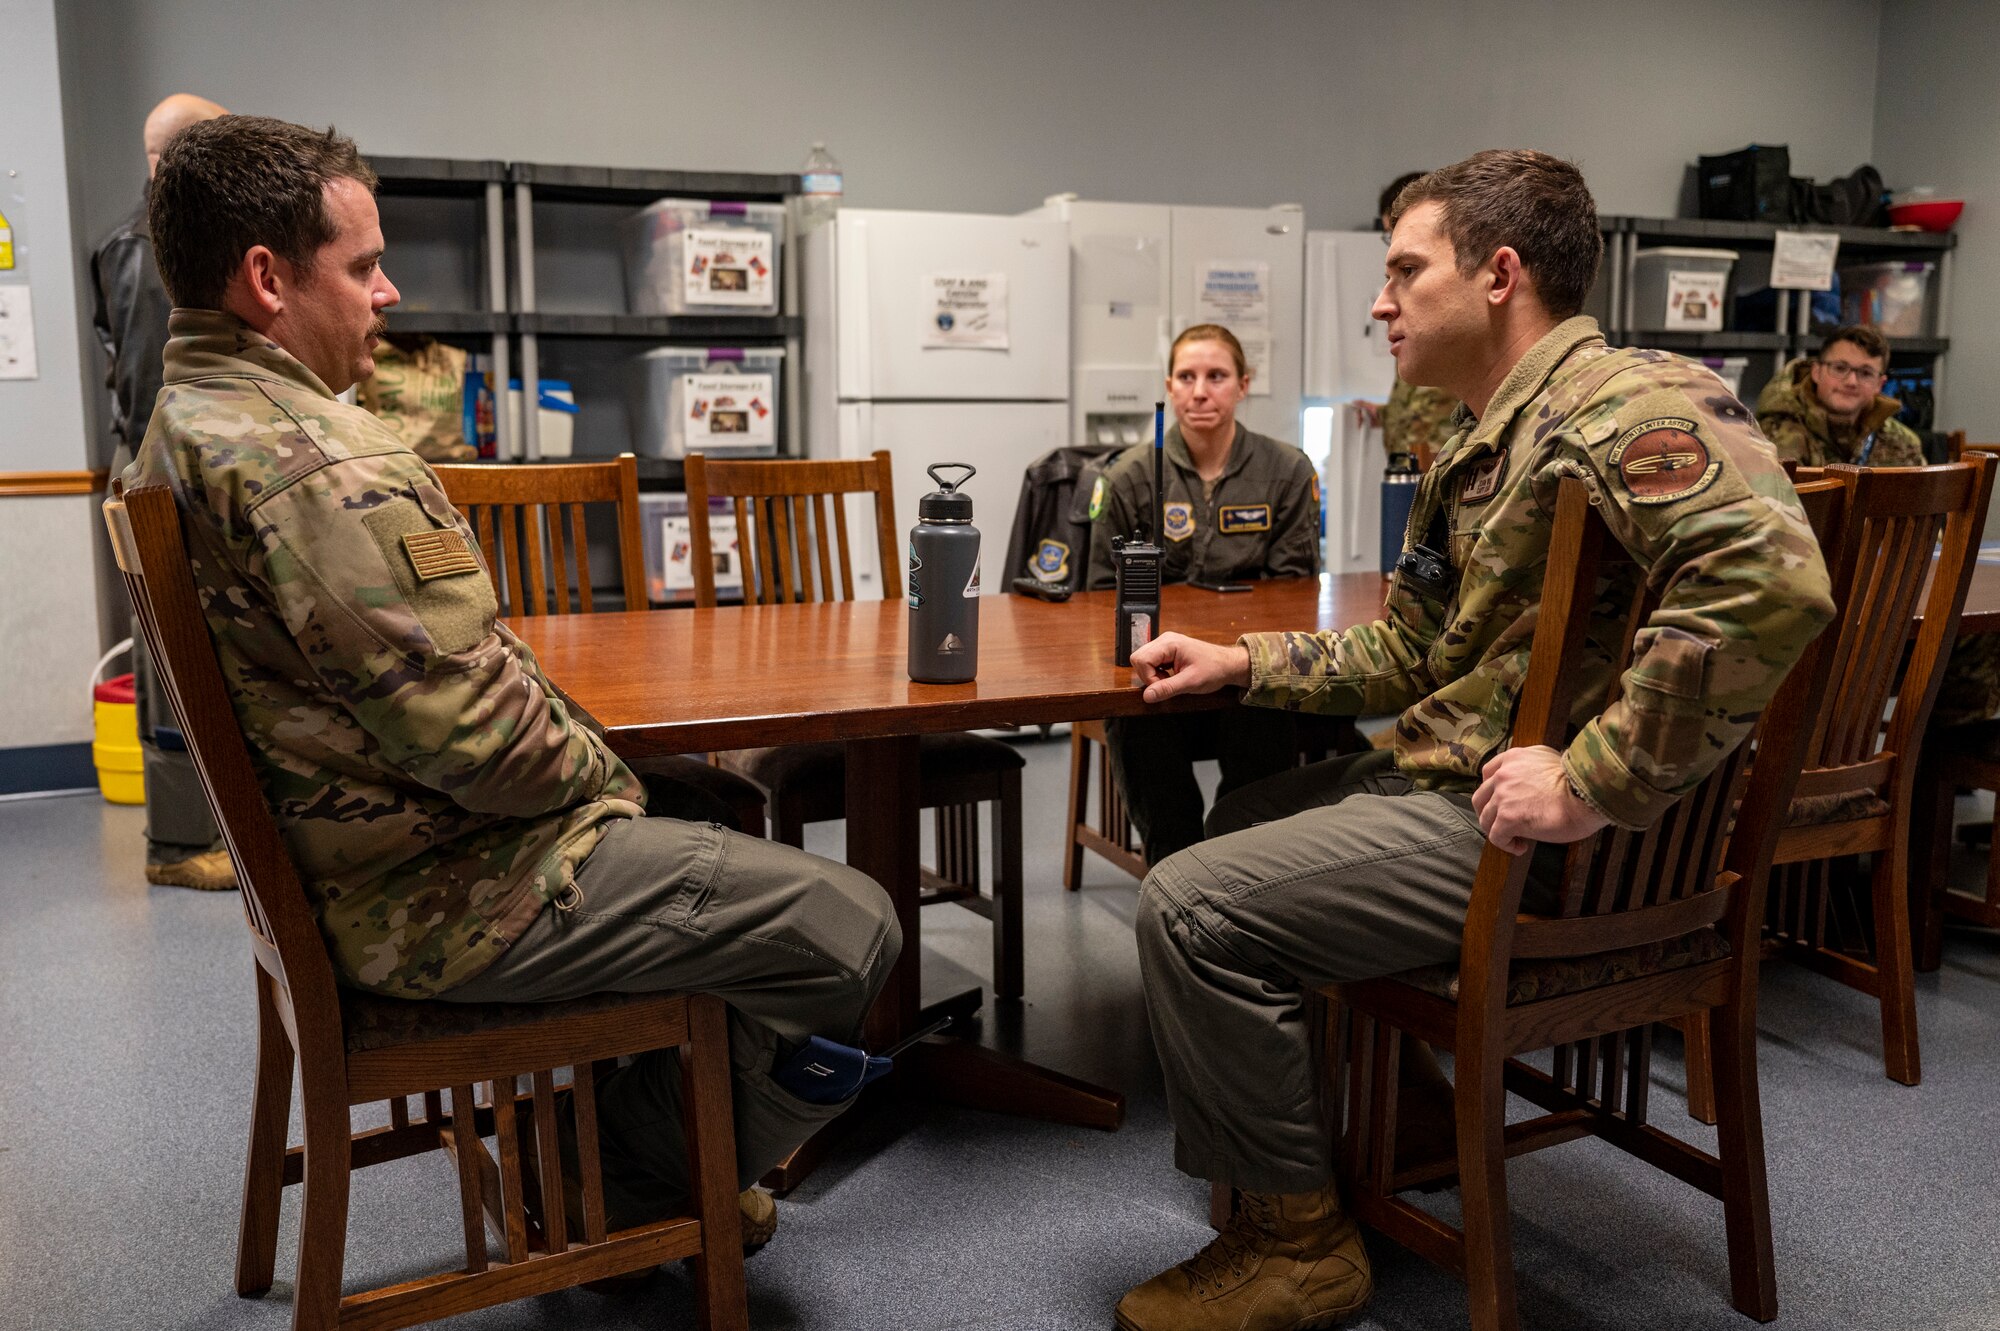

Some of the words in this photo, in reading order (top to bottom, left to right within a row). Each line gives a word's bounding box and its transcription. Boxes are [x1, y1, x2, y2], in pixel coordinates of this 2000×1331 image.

[934, 278, 957, 287] USAF
[968, 279, 988, 288] ANG
[937, 299, 989, 309] Refrigerator
[1615, 426, 1645, 450] POTENTIA
[1644, 420, 1667, 431] INTER
[1667, 420, 1691, 430] ASTRA
